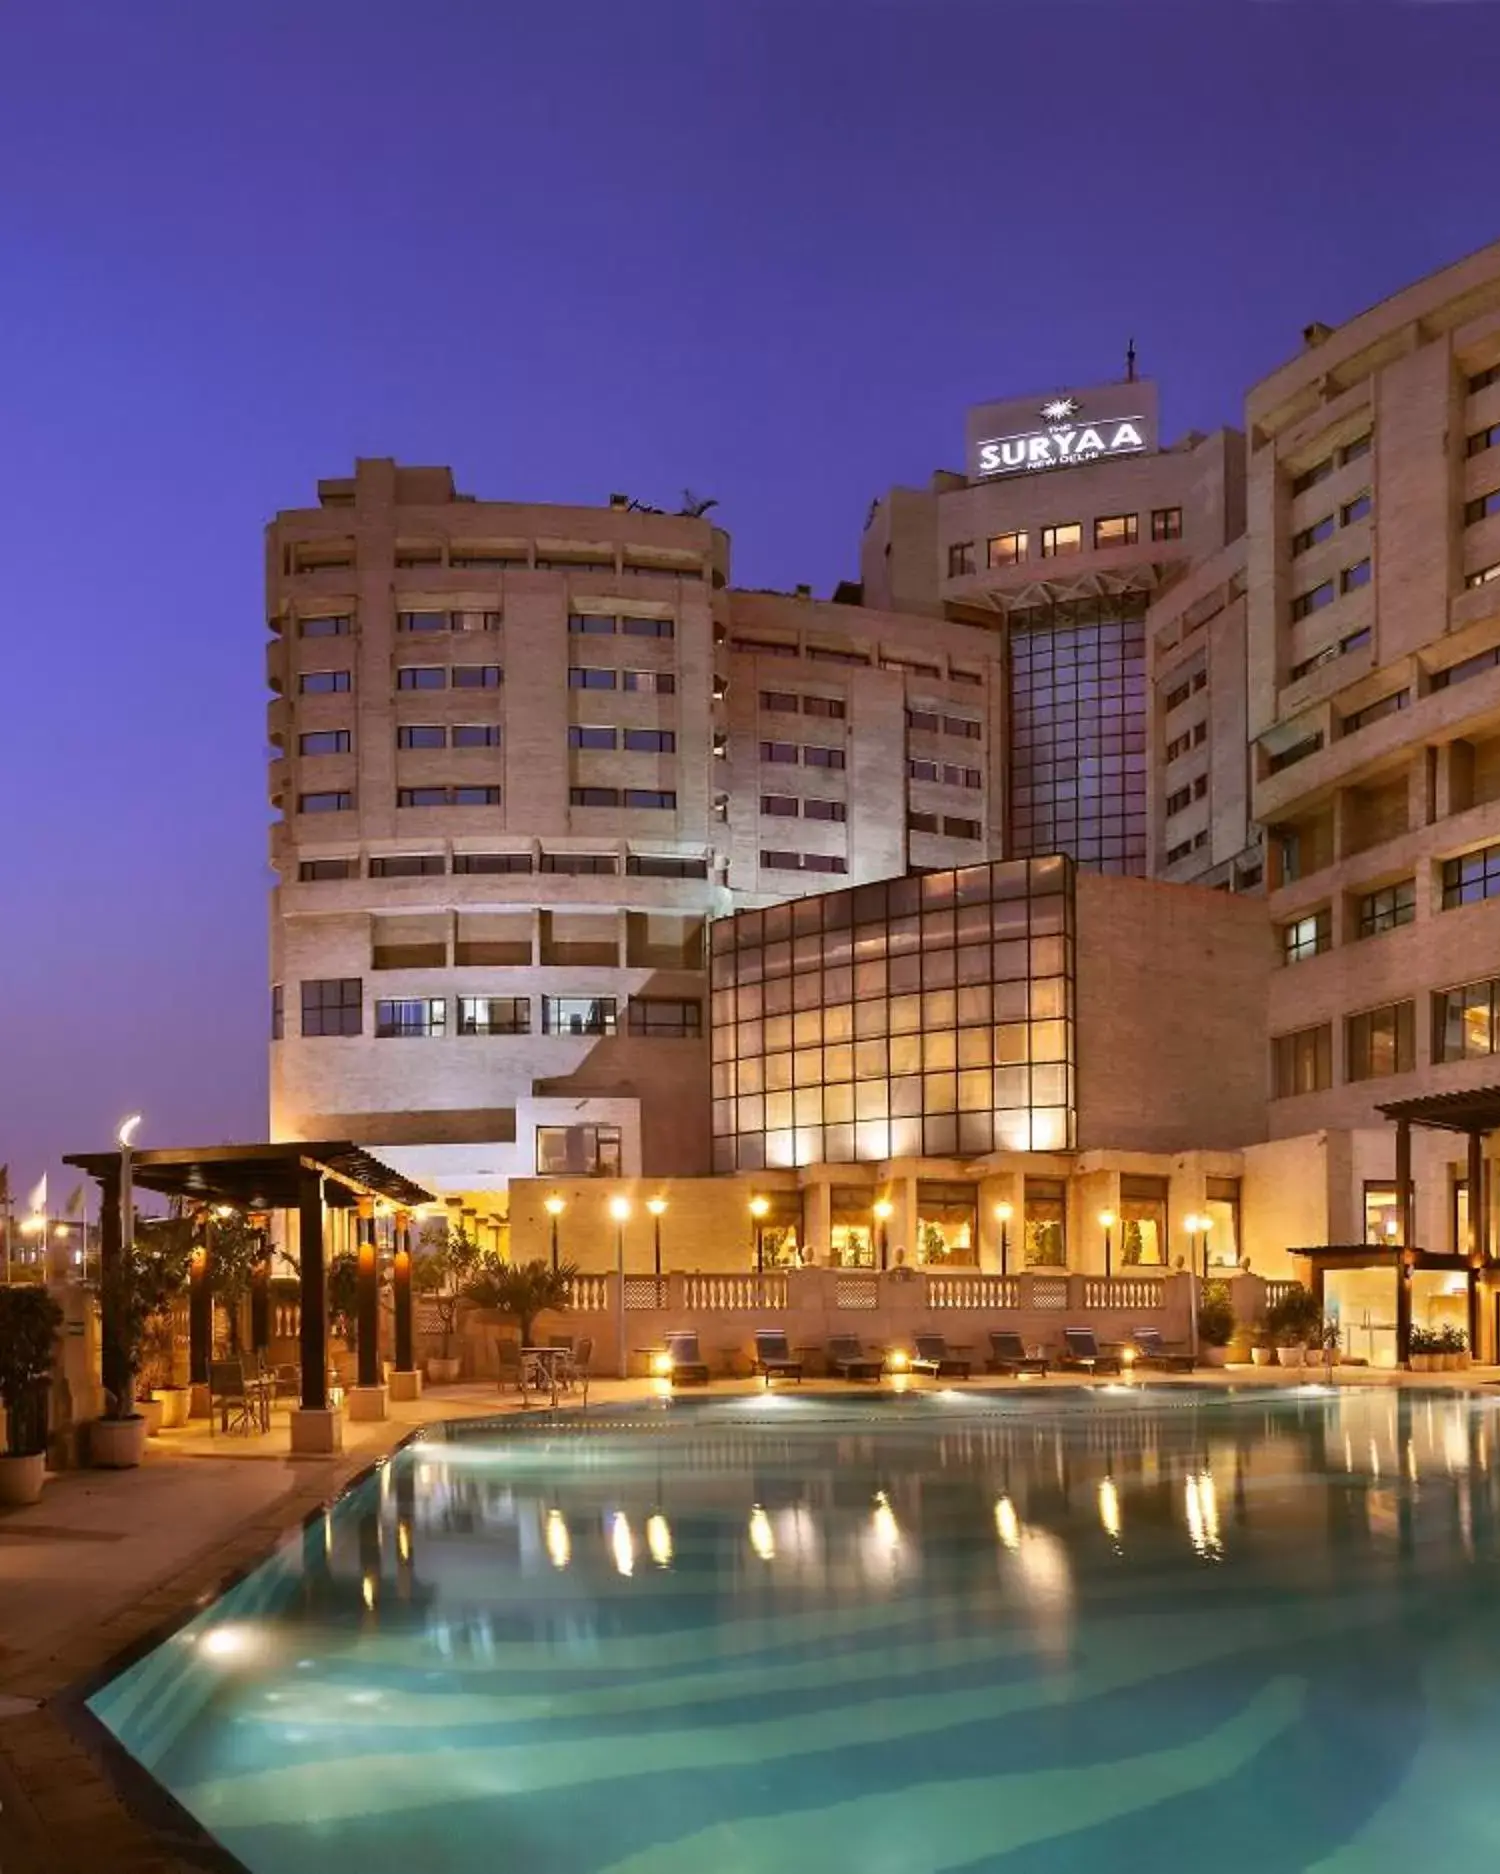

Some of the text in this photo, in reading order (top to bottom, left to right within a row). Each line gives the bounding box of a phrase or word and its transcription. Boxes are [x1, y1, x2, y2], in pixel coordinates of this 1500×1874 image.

[979, 423, 1143, 470] SURYAA
[1026, 451, 1099, 470] NEW DELHI
